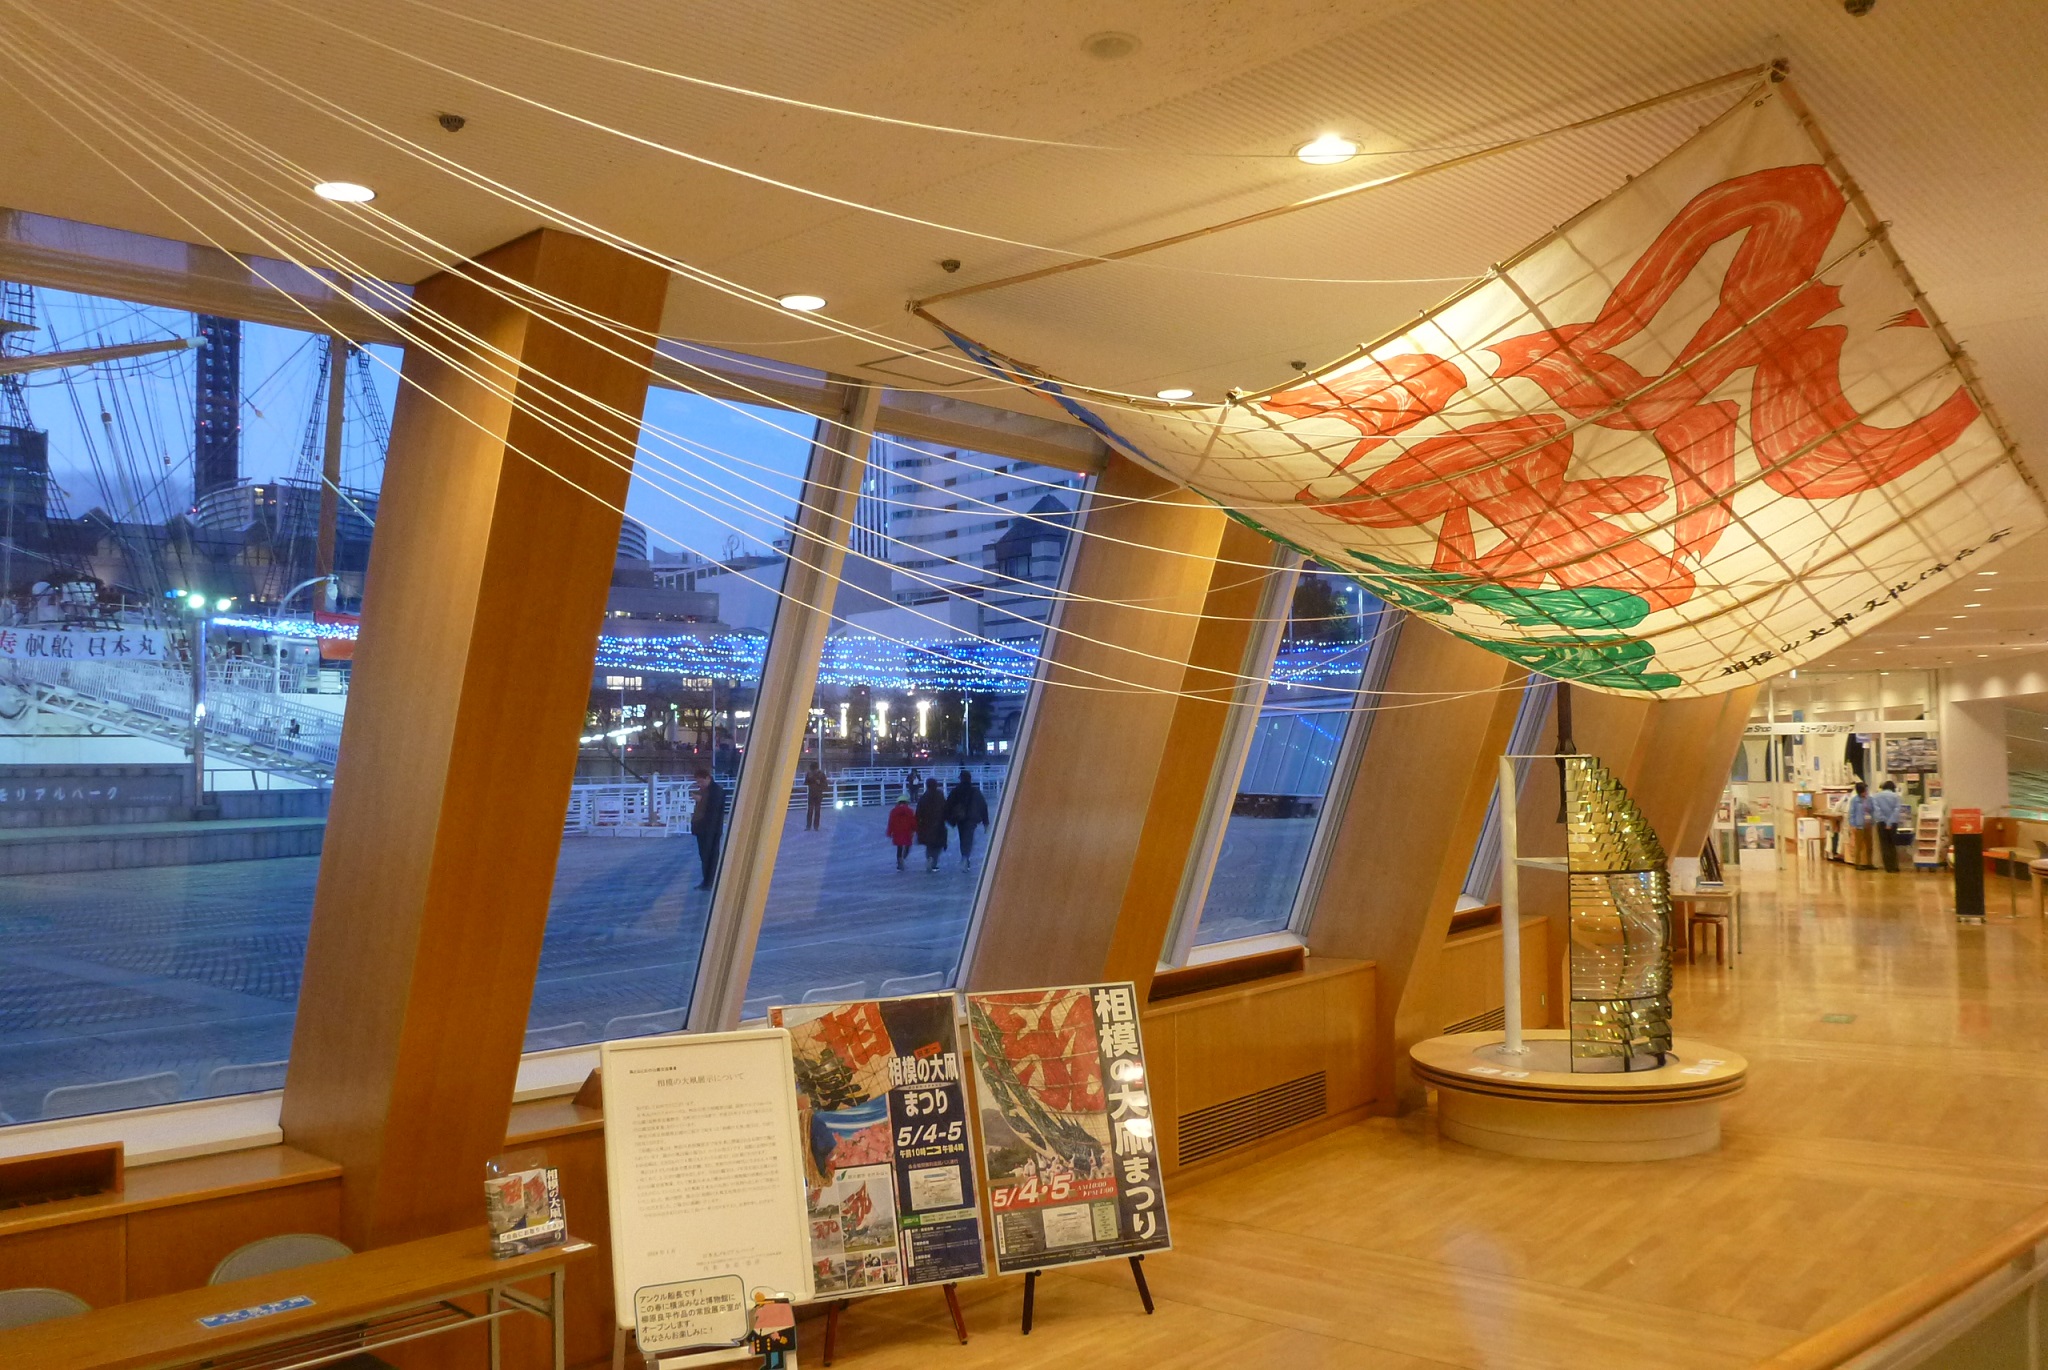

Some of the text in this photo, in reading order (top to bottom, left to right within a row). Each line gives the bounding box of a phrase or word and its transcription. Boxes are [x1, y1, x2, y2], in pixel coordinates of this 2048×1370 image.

[88, 634, 157, 657] 日本丸
[1800, 724, 1855, 733] ミュージアムショップ
[888, 1052, 959, 1086] 相模の大凧
[904, 1089, 948, 1117] まつり
[897, 1121, 963, 1147] 5/4-5
